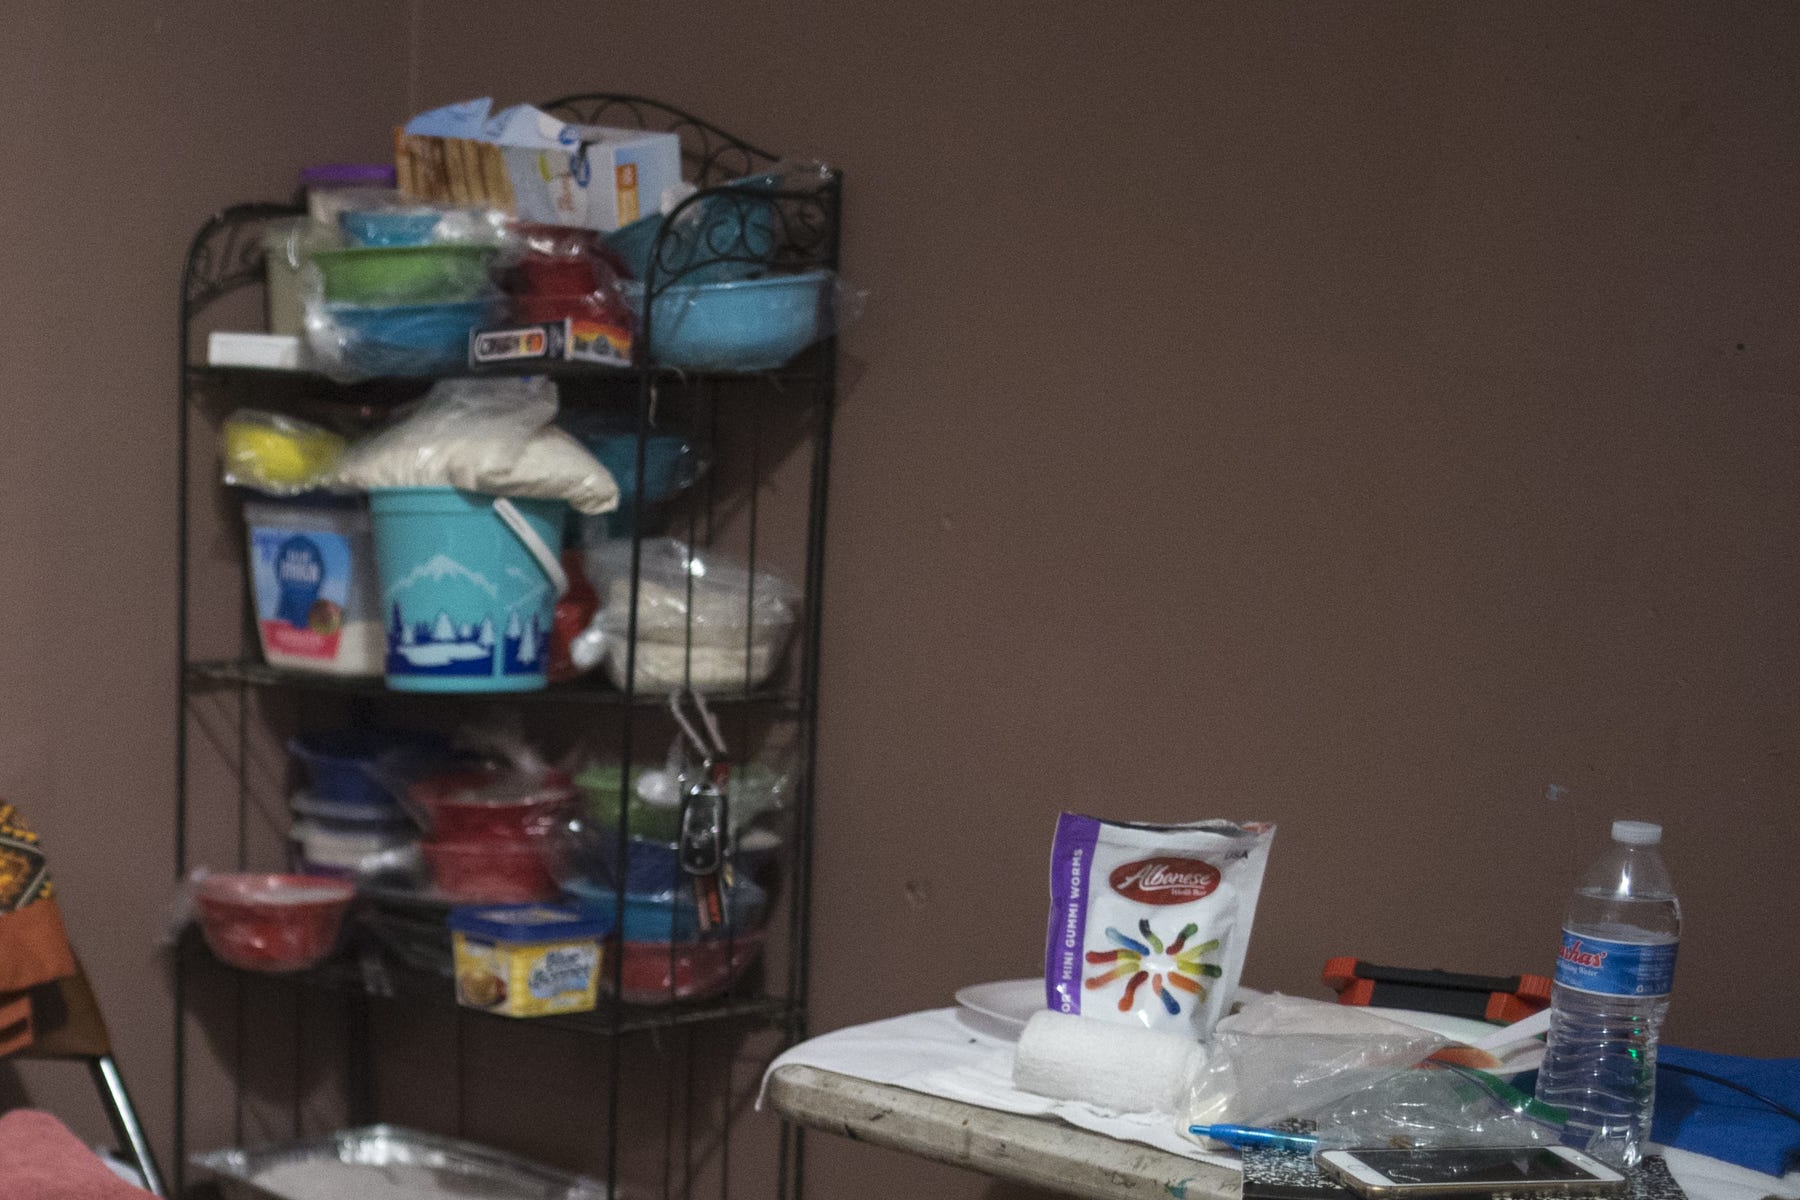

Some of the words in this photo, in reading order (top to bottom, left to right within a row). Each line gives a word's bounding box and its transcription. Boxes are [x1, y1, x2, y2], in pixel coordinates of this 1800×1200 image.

[1069, 848, 1084, 899] WORMS
[1117, 863, 1212, 891] Albanese
[1065, 901, 1078, 947] GUMMI
[1063, 951, 1073, 979] MINI
